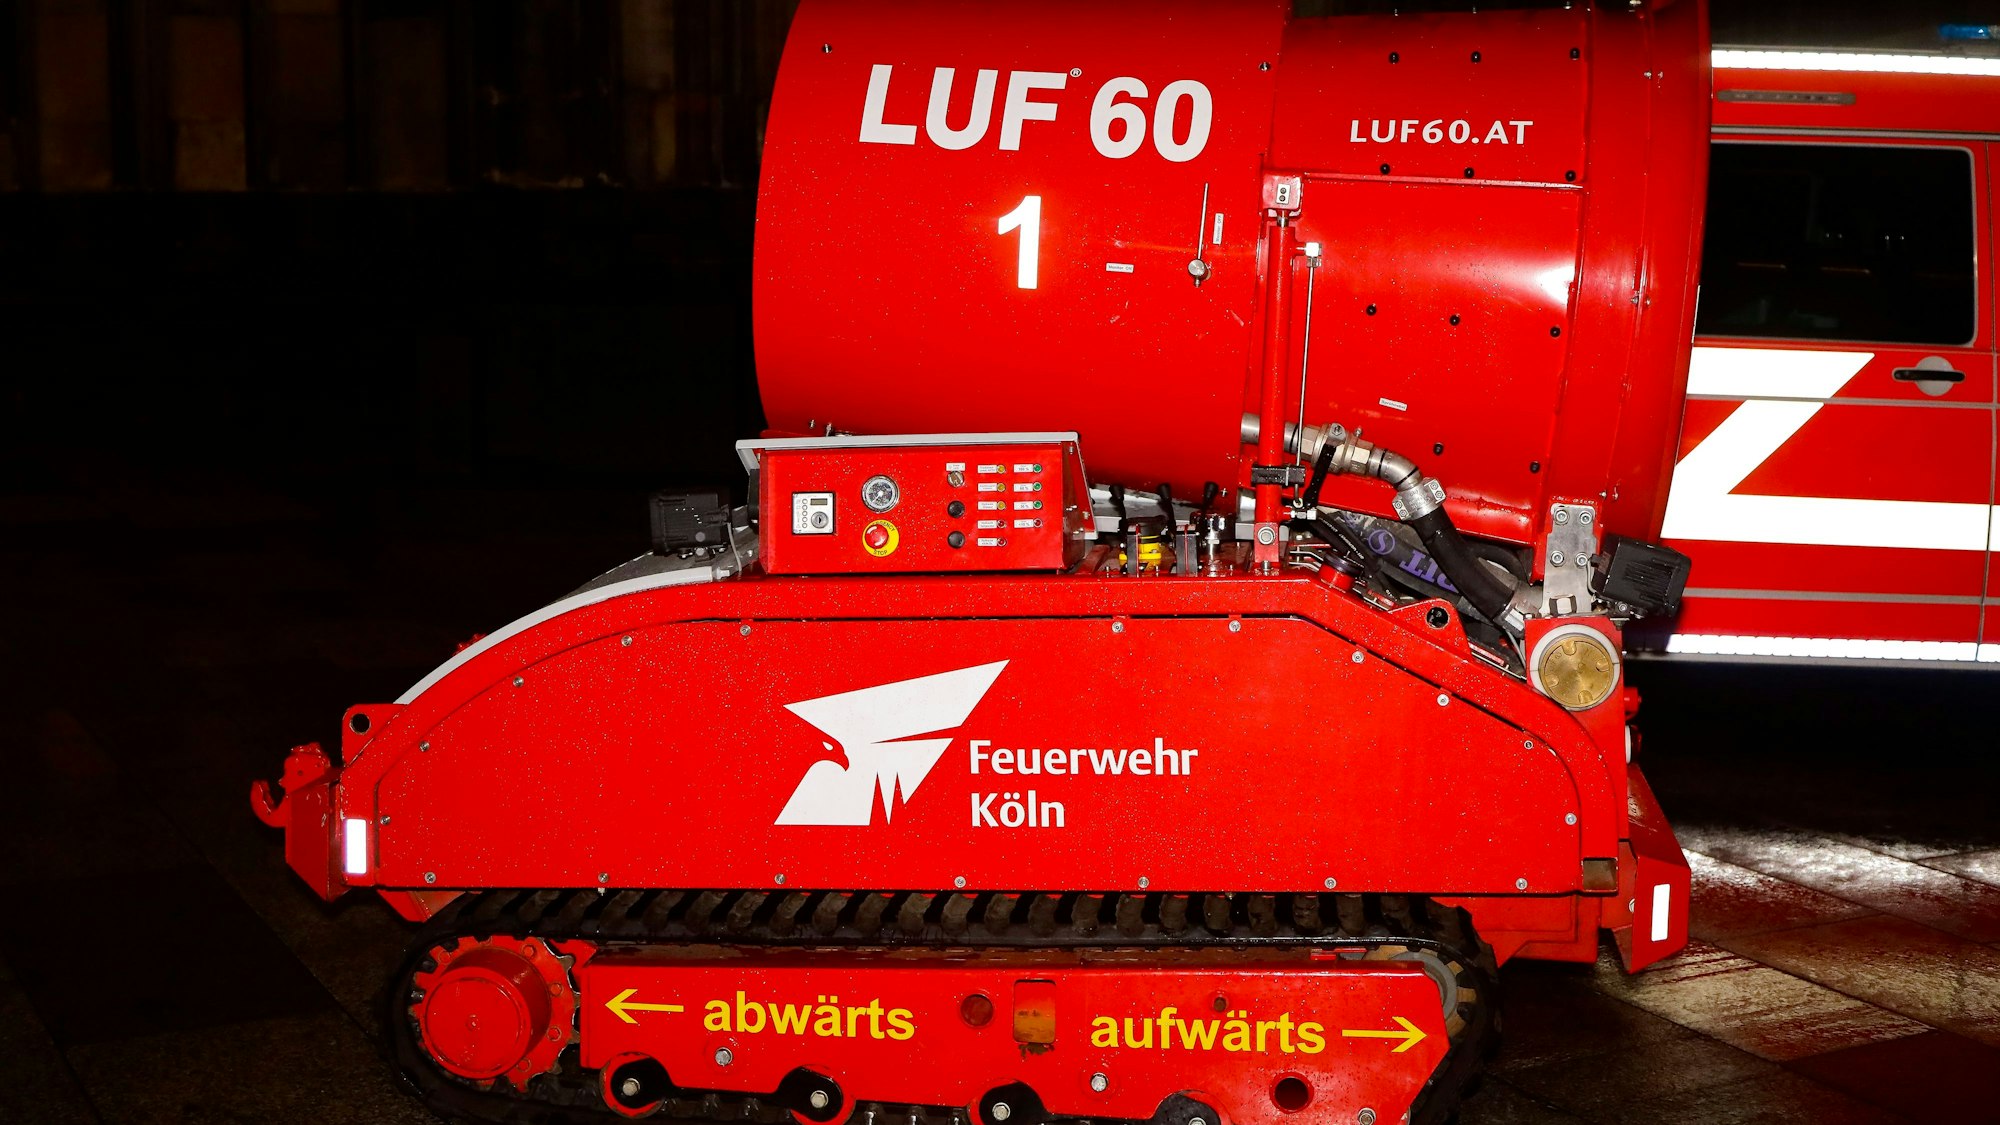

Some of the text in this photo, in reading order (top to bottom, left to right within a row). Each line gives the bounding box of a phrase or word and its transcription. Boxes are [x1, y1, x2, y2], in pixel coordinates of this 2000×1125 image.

[1090, 77, 1212, 162] 60
[1350, 119, 1533, 145] LUF60.AT
[998, 195, 1042, 289] 1
[969, 737, 1199, 776] Feuerwehr
[971, 790, 1065, 828] Köln
[703, 990, 915, 1040] abwärts
[1091, 1006, 1326, 1054] aufwärts
